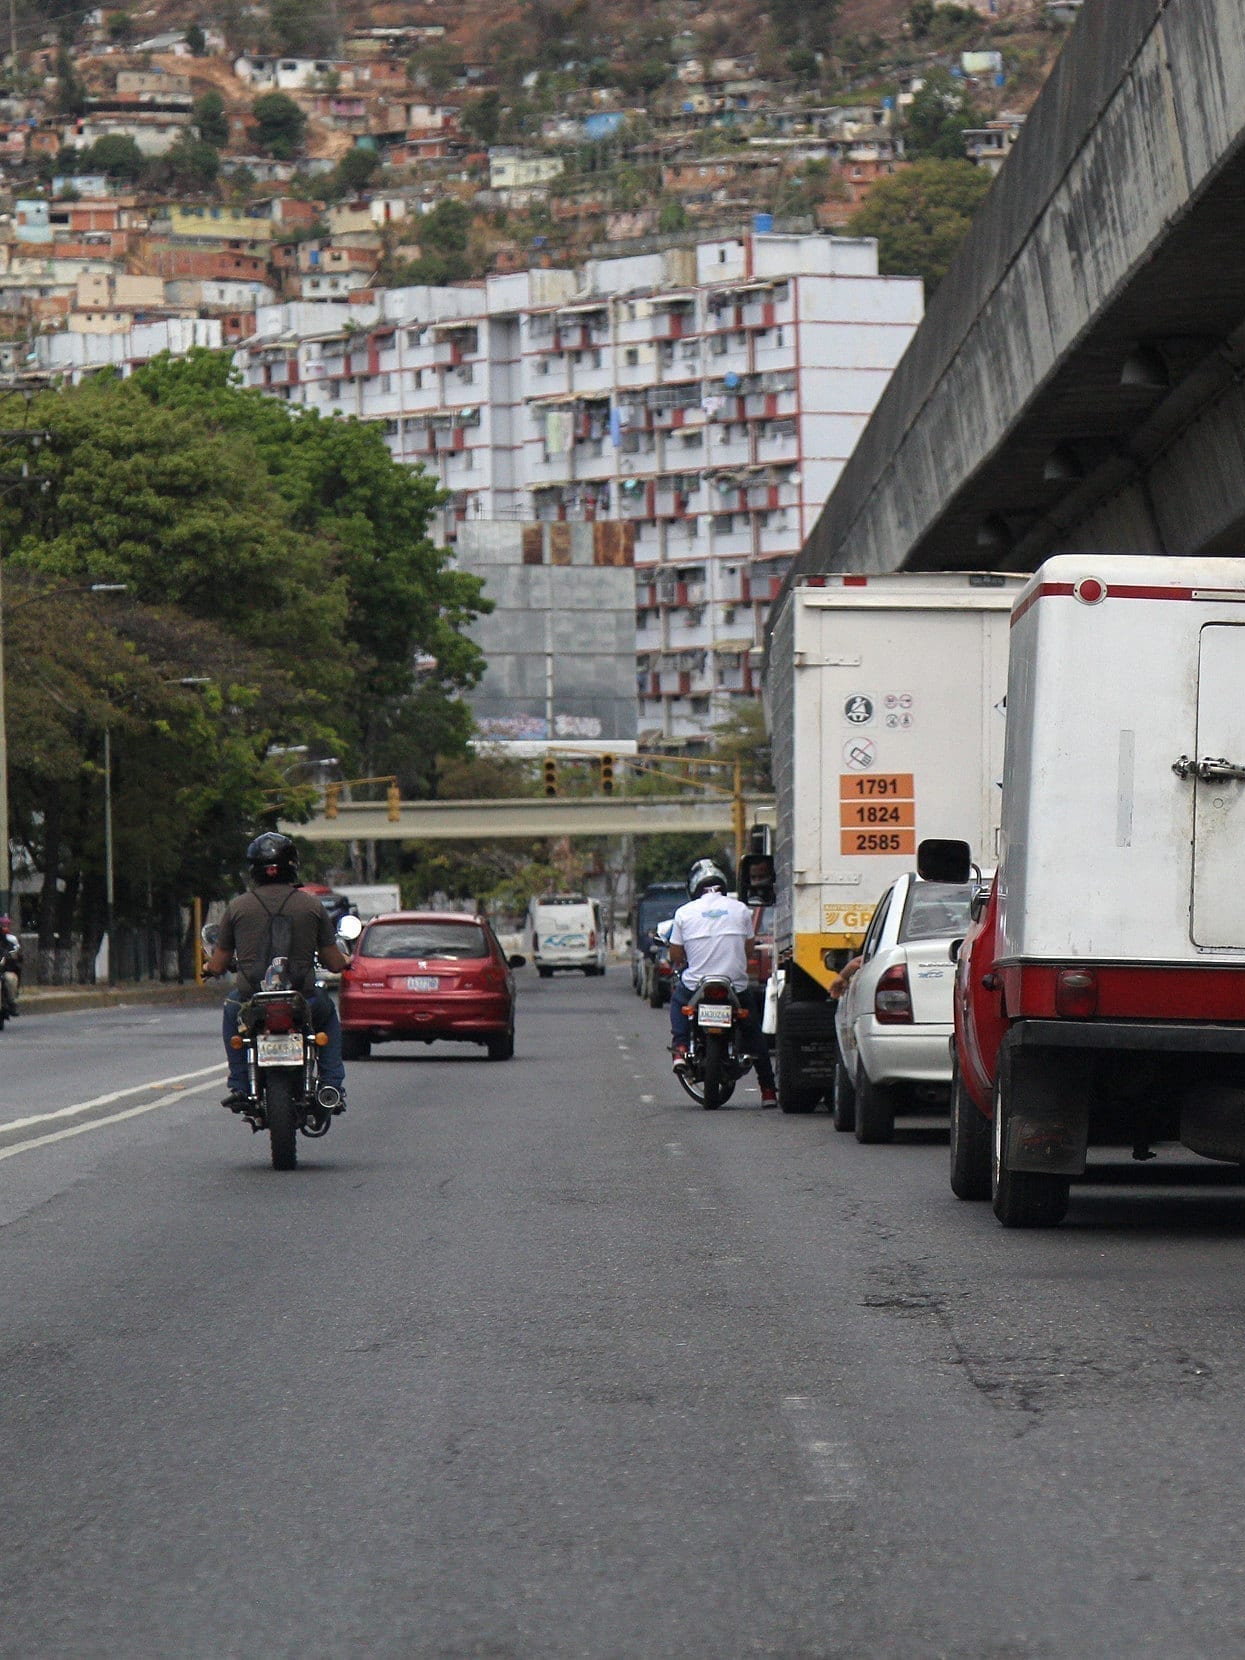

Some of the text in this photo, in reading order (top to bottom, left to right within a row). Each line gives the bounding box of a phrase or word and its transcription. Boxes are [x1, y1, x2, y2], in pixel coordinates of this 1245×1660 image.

[856, 778, 897, 794] 1791
[856, 807, 900, 822] 1824
[856, 834, 900, 850] 2585
[843, 911, 872, 927] GP
